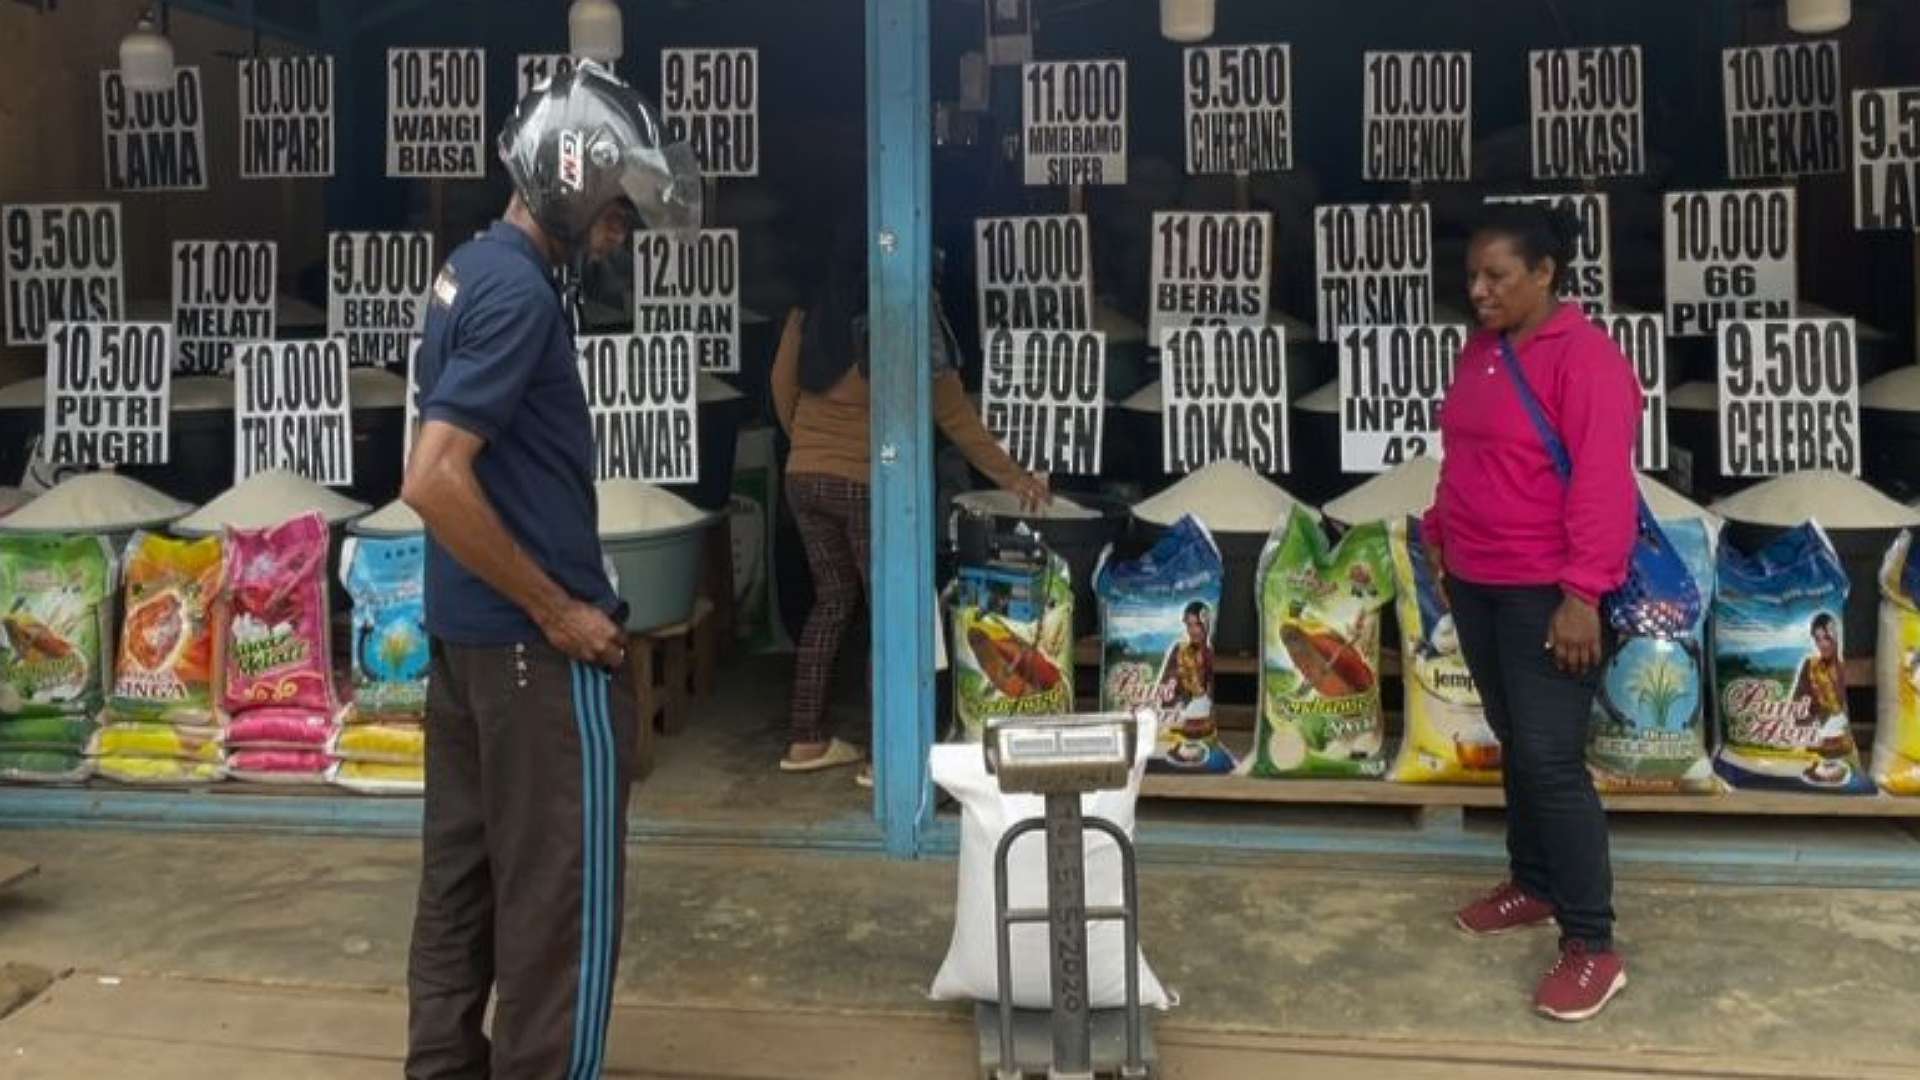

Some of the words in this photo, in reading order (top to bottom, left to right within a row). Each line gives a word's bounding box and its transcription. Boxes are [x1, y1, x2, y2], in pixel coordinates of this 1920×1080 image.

[105, 72, 199, 129] 9.000
[244, 58, 329, 114] 10.000
[393, 52, 481, 109] 10.500
[667, 53, 752, 110] 9.500
[1027, 63, 1121, 122] 11.000
[1189, 48, 1285, 109] 9.500
[1370, 54, 1467, 115] 10.000
[1536, 50, 1637, 111] 10.500
[1729, 44, 1836, 111] 10.000
[244, 118, 330, 172] INPARI
[393, 115, 480, 142] WANGI
[399, 146, 476, 172] BIASA
[1191, 110, 1287, 172] CIHERANG
[1538, 113, 1640, 176] LOKASI
[1732, 111, 1840, 176] MEKAR
[110, 132, 200, 188] LAMA
[1047, 158, 1104, 184] SUPER
[1860, 162, 1920, 228] LA
[7, 208, 116, 270] 9.500
[982, 218, 1083, 284] 10.000
[1159, 216, 1262, 280] 11.000
[1320, 205, 1428, 272] 10.000
[1672, 193, 1787, 261] 10.000
[177, 243, 272, 304] 11.000
[334, 236, 427, 295] 9.000
[638, 234, 734, 297] 12.000
[1705, 265, 1755, 297] 66
[11, 277, 118, 340] LOKASI
[177, 308, 271, 337] MELATI
[344, 300, 415, 328] BERAS
[641, 305, 731, 333] TAILAN
[1159, 284, 1260, 315] BERAS
[1673, 301, 1788, 333] PULEN
[54, 326, 164, 392] 10.500
[179, 342, 233, 372] SUP
[242, 342, 342, 411] 10.000
[336, 333, 421, 363] AMPU
[583, 336, 689, 406] 10.000
[989, 331, 1098, 401] 9.000
[1167, 327, 1281, 399] 10.000
[1725, 322, 1850, 396] 9.500
[57, 396, 160, 427] PUTRI
[1169, 402, 1286, 473] LOKASI
[1728, 401, 1853, 474] CELEBES
[53, 431, 162, 463] ANGRI
[242, 417, 275, 480] TRI
[281, 415, 346, 482] SAKTI
